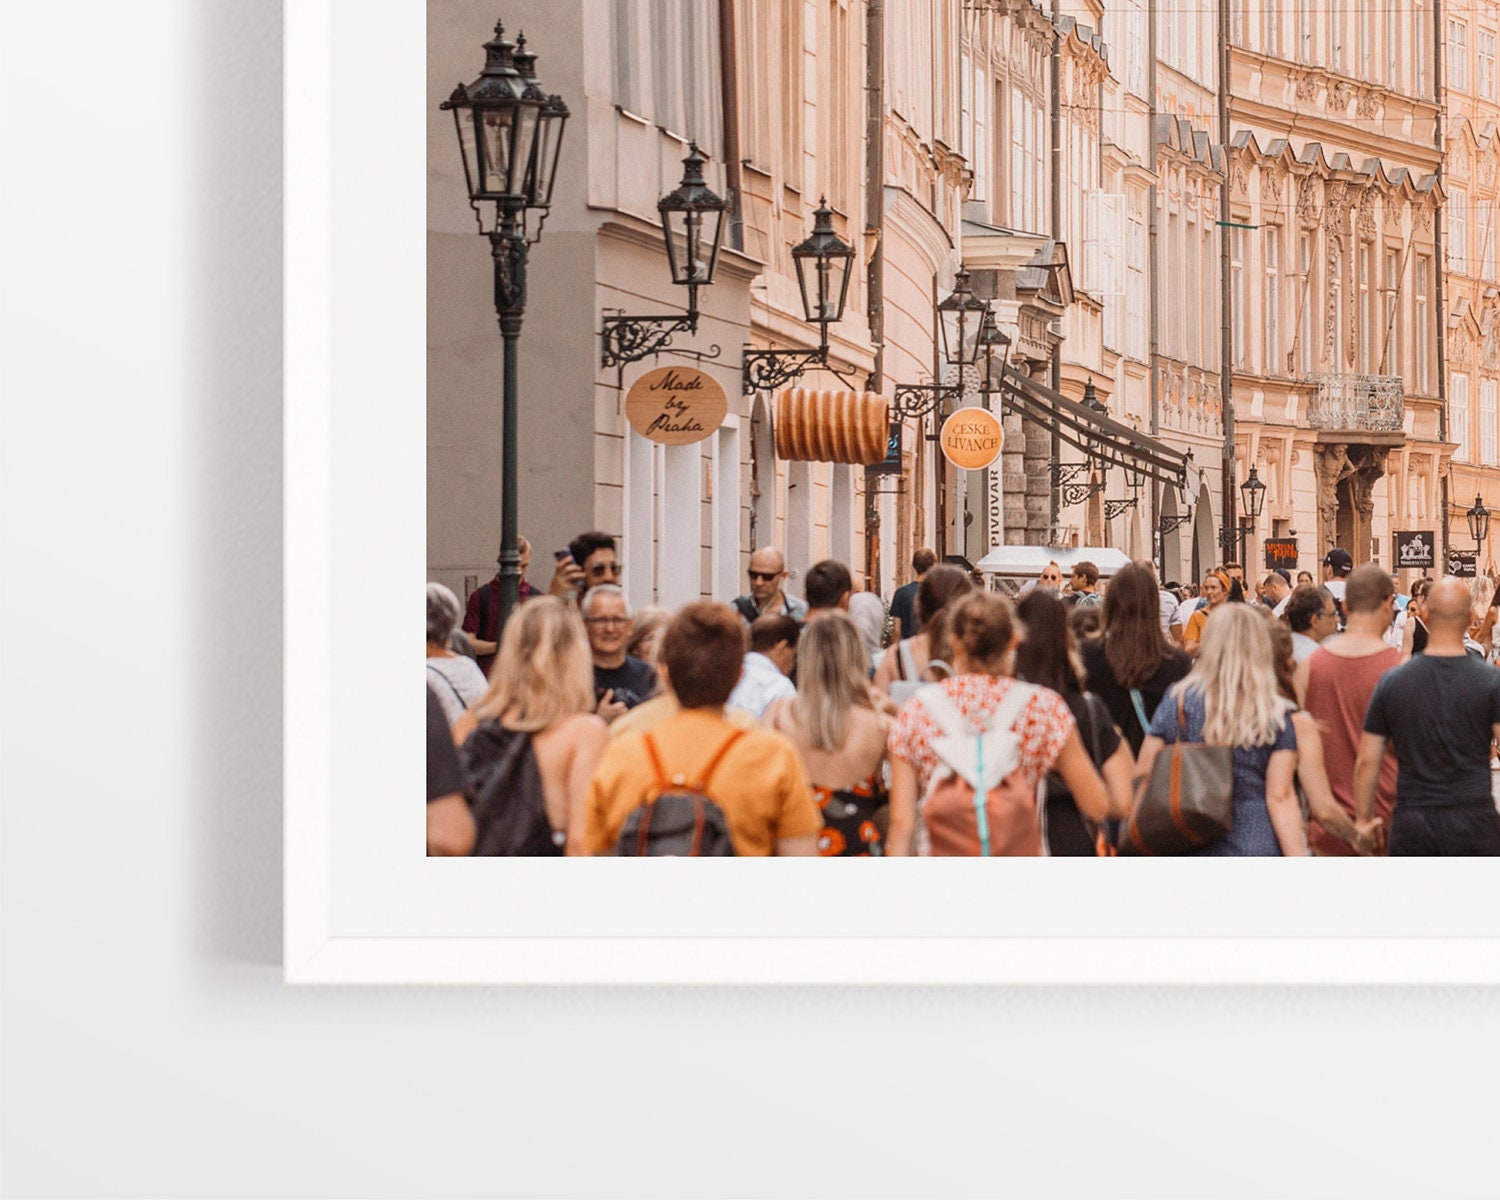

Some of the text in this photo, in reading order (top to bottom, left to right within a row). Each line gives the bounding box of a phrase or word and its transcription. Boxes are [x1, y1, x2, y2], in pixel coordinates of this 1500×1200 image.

[649, 369, 704, 391] Made
[664, 394, 691, 418] by
[645, 413, 705, 436] Praha
[947, 434, 999, 452] LÍVANCE
[989, 469, 1000, 547] PIVOVAR
